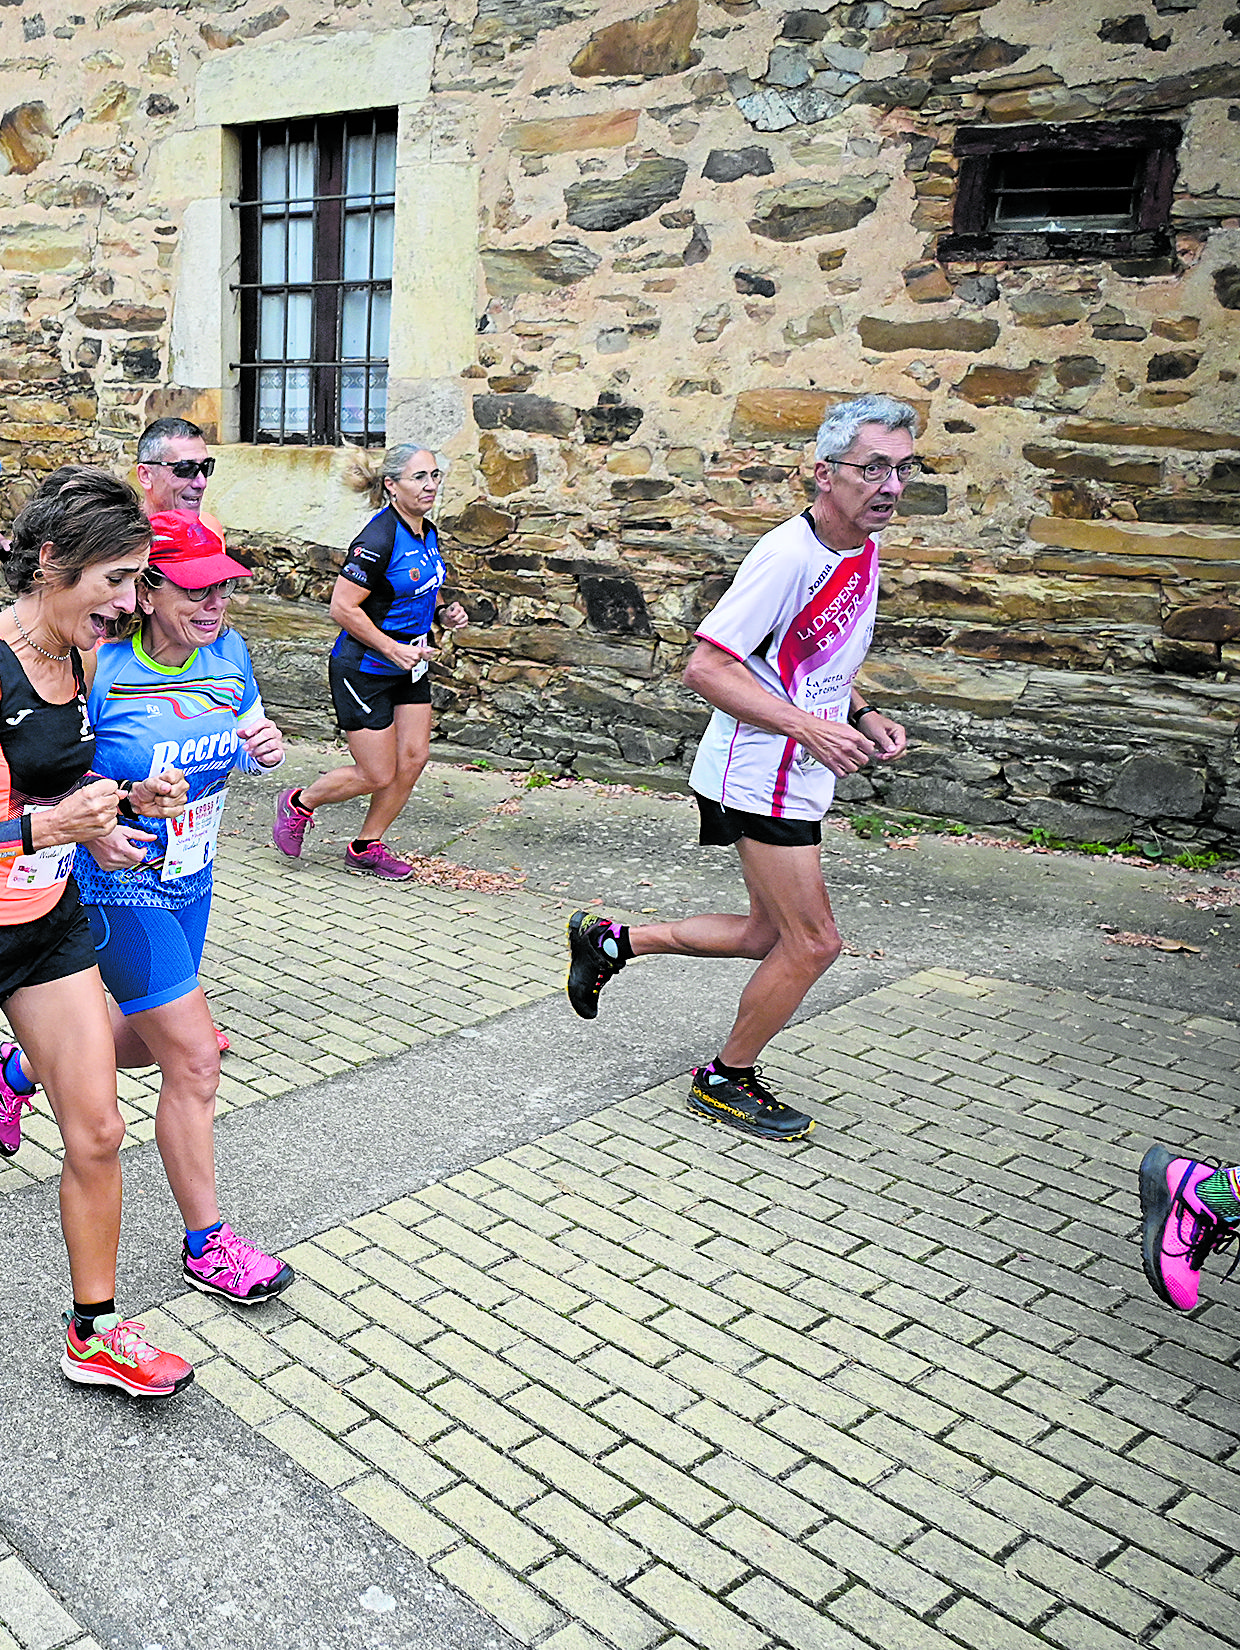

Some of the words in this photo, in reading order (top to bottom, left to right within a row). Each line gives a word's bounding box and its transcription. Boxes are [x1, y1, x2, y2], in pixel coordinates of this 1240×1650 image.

[807, 563, 833, 596] Joma
[796, 627, 816, 641] LA
[812, 571, 862, 632] DESPENSA
[815, 630, 837, 652] DE
[832, 593, 864, 637] FER
[195, 800, 214, 816] CROSS
[203, 841, 210, 864] 8
